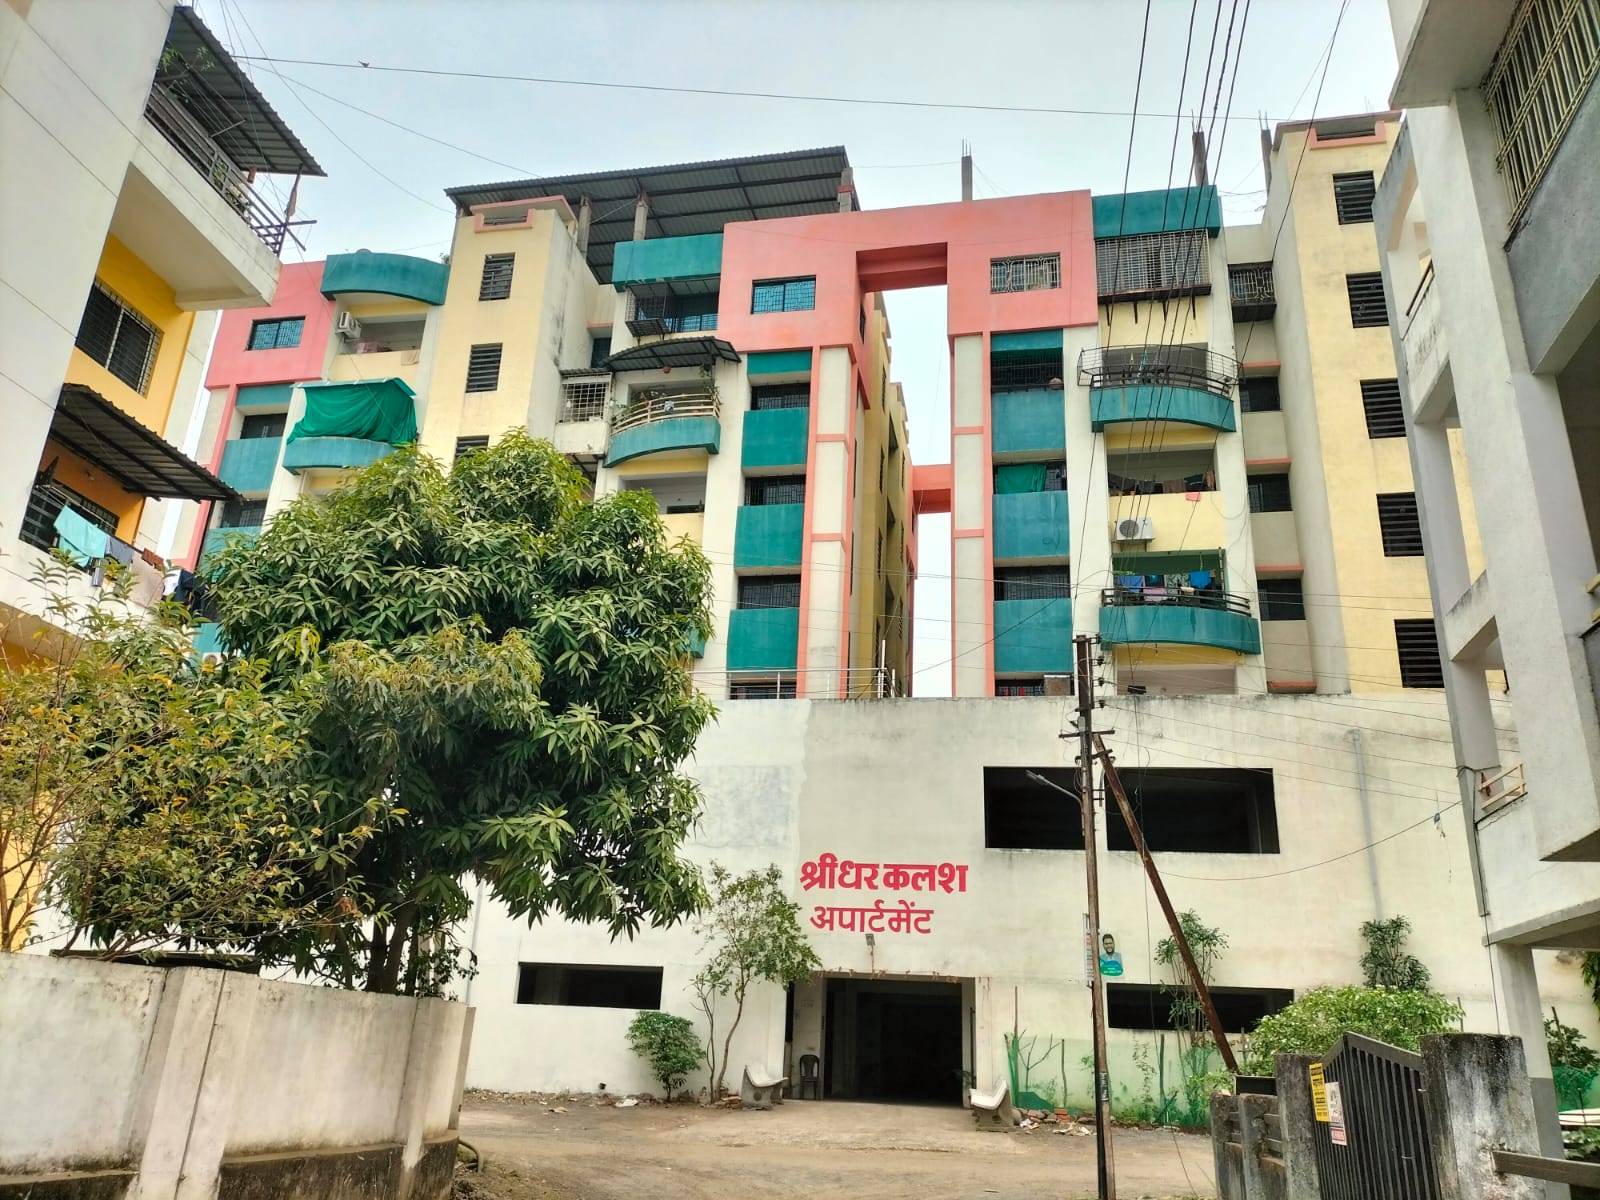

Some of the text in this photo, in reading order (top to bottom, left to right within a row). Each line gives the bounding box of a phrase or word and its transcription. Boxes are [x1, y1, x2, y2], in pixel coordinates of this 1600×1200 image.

[800, 853, 969, 894] श्रीधर कलश
[810, 899, 934, 934] अपार्टमेंट
